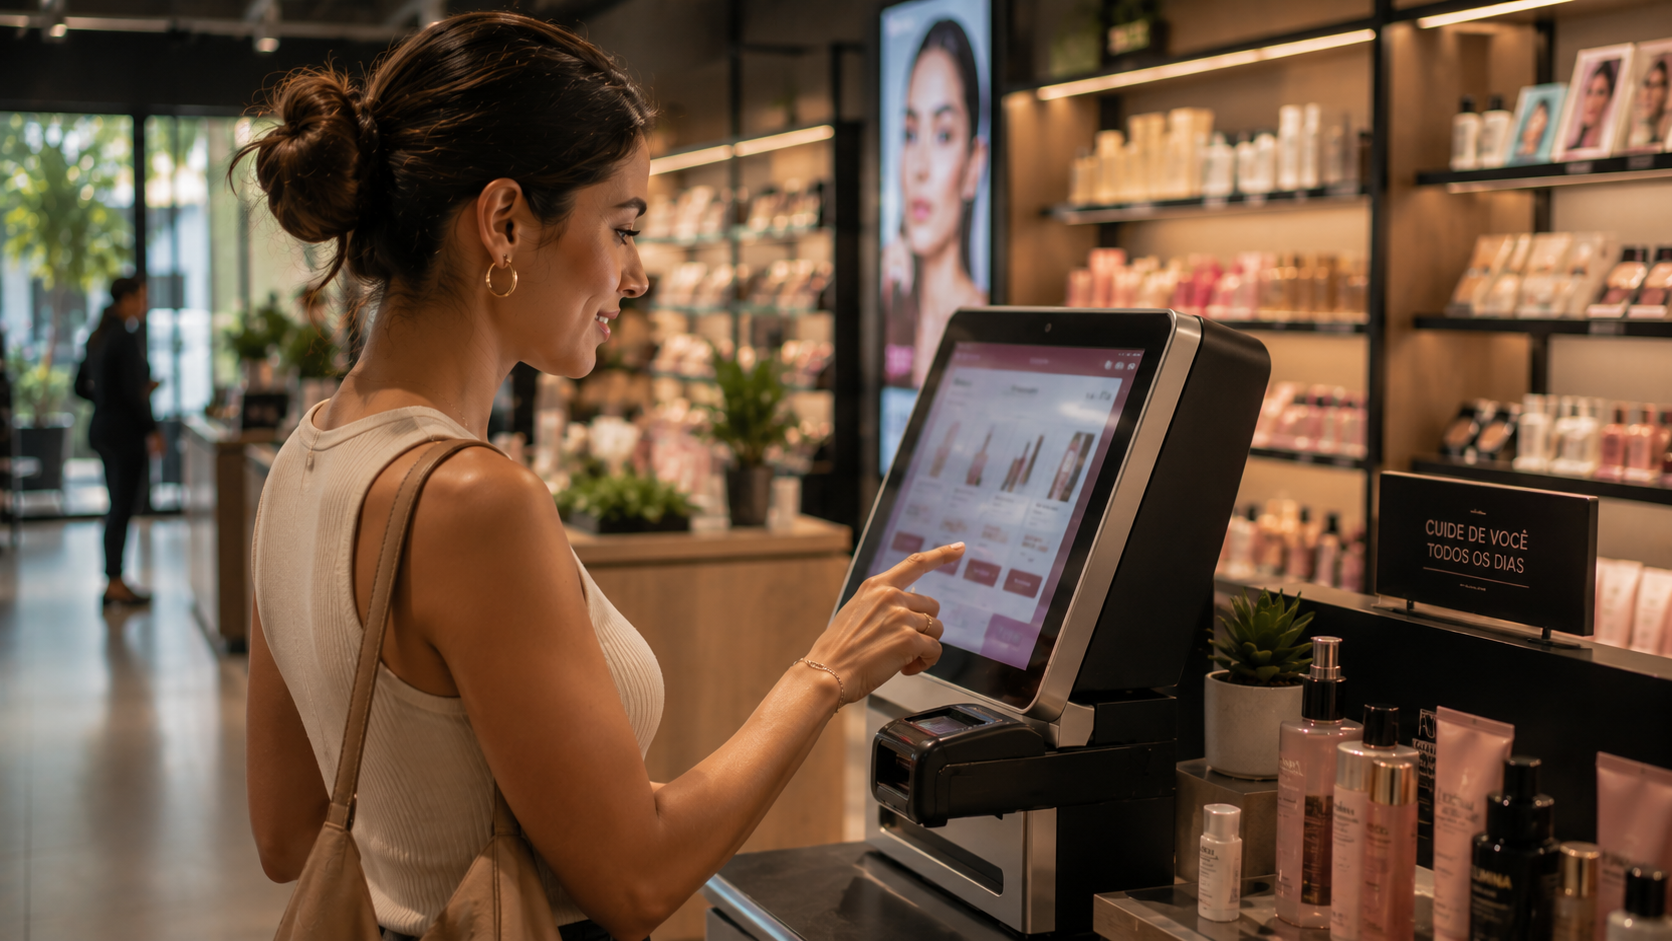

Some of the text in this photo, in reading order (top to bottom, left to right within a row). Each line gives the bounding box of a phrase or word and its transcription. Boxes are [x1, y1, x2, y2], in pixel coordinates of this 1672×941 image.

[1425, 519, 1529, 550] CUIDE DE VOCÊ
[1427, 542, 1525, 574] TODOS OS DIAS
